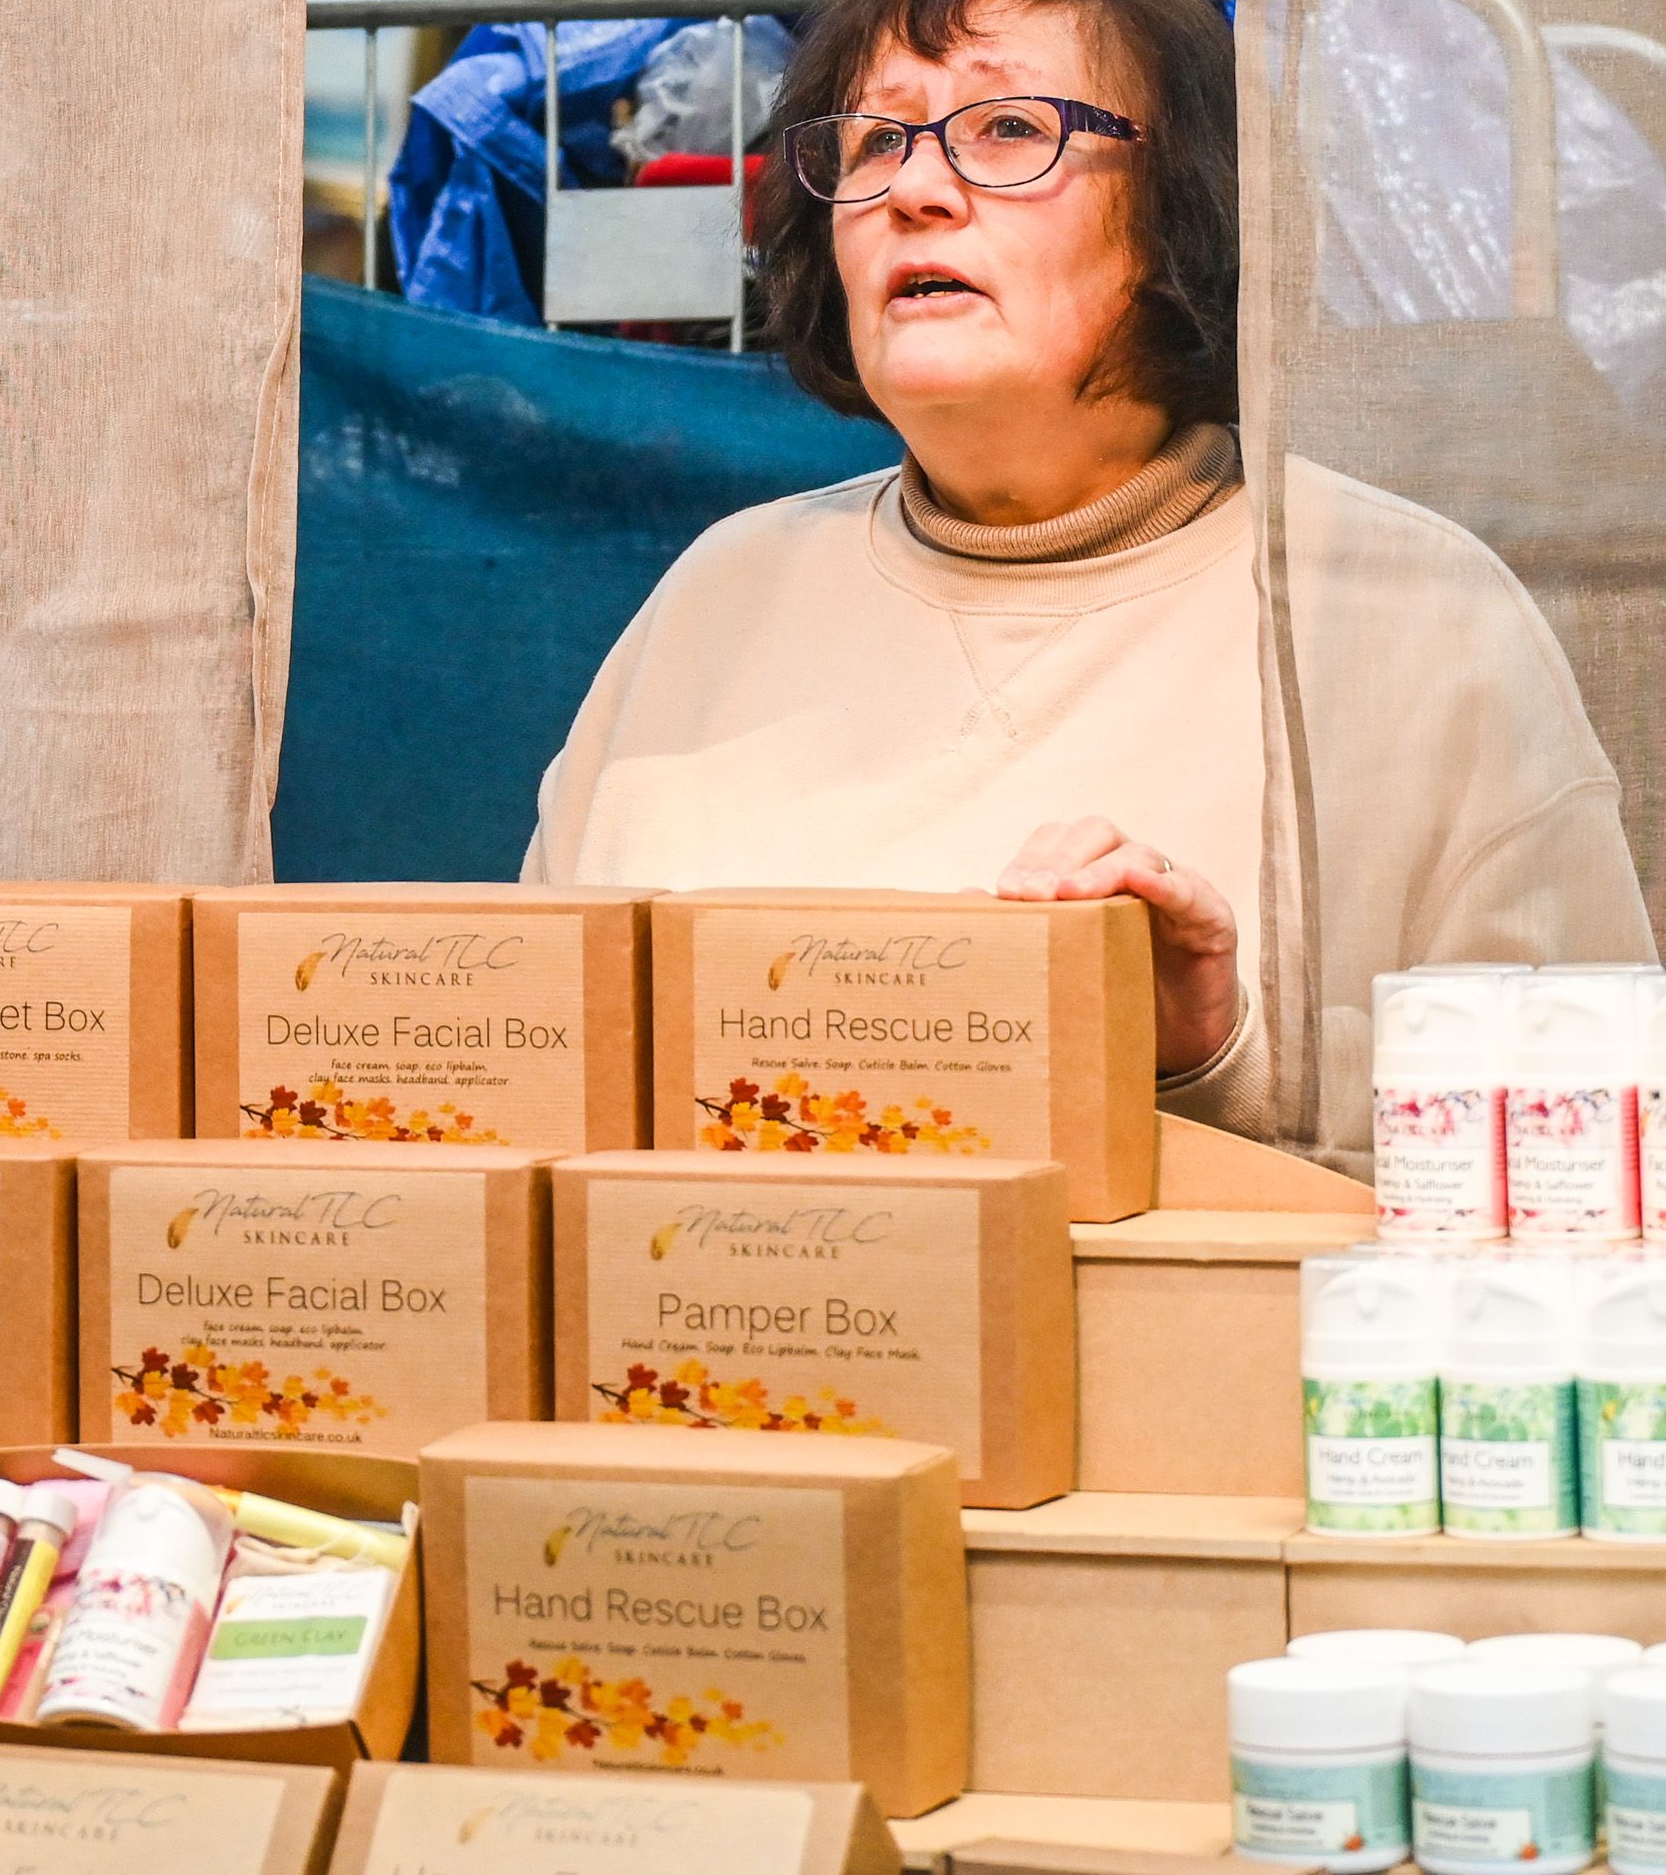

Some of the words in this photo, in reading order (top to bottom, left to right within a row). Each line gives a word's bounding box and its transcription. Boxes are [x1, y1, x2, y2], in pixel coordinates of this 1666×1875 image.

[321, 933, 435, 977] Natural
[436, 934, 523, 970] TLC
[791, 934, 892, 977] Natural
[892, 935, 971, 970] TLC
[370, 972, 473, 986] SKINCARE
[834, 972, 927, 986] SKINCARE
[45, 1001, 105, 1032] Box
[720, 1008, 811, 1040] Hand
[826, 1009, 953, 1042] Rescue
[967, 1011, 1032, 1043] Box
[267, 1014, 380, 1046] Deluxe
[394, 1016, 490, 1048] Facial
[505, 1018, 568, 1049] Box
[33, 1052, 51, 1062] spa
[331, 1059, 352, 1070] face
[425, 1062, 443, 1071] eco
[751, 1057, 787, 1069] Rescue
[858, 1059, 895, 1071] Cuticle
[934, 1061, 971, 1072] Cotton
[309, 1074, 331, 1085] clay
[333, 1074, 355, 1083] face
[455, 1074, 509, 1087] applicator
[193, 1188, 311, 1237] Natural
[312, 1191, 401, 1229] TLC
[243, 1230, 350, 1246] SKINCARE
[677, 1204, 799, 1248] Natural
[798, 1208, 891, 1243] TLC
[730, 1243, 839, 1259] SKINCARE
[138, 1273, 253, 1308] Deluxe
[267, 1277, 367, 1310] Facial
[382, 1279, 447, 1313] Box
[659, 1293, 811, 1340] Pamper
[826, 1298, 897, 1335] Box
[1367, 1447, 1423, 1465] Cream
[1617, 1450, 1664, 1469] Hand
[495, 1584, 592, 1622] Hand
[607, 1588, 743, 1628] Rescue
[758, 1594, 829, 1633] Box
